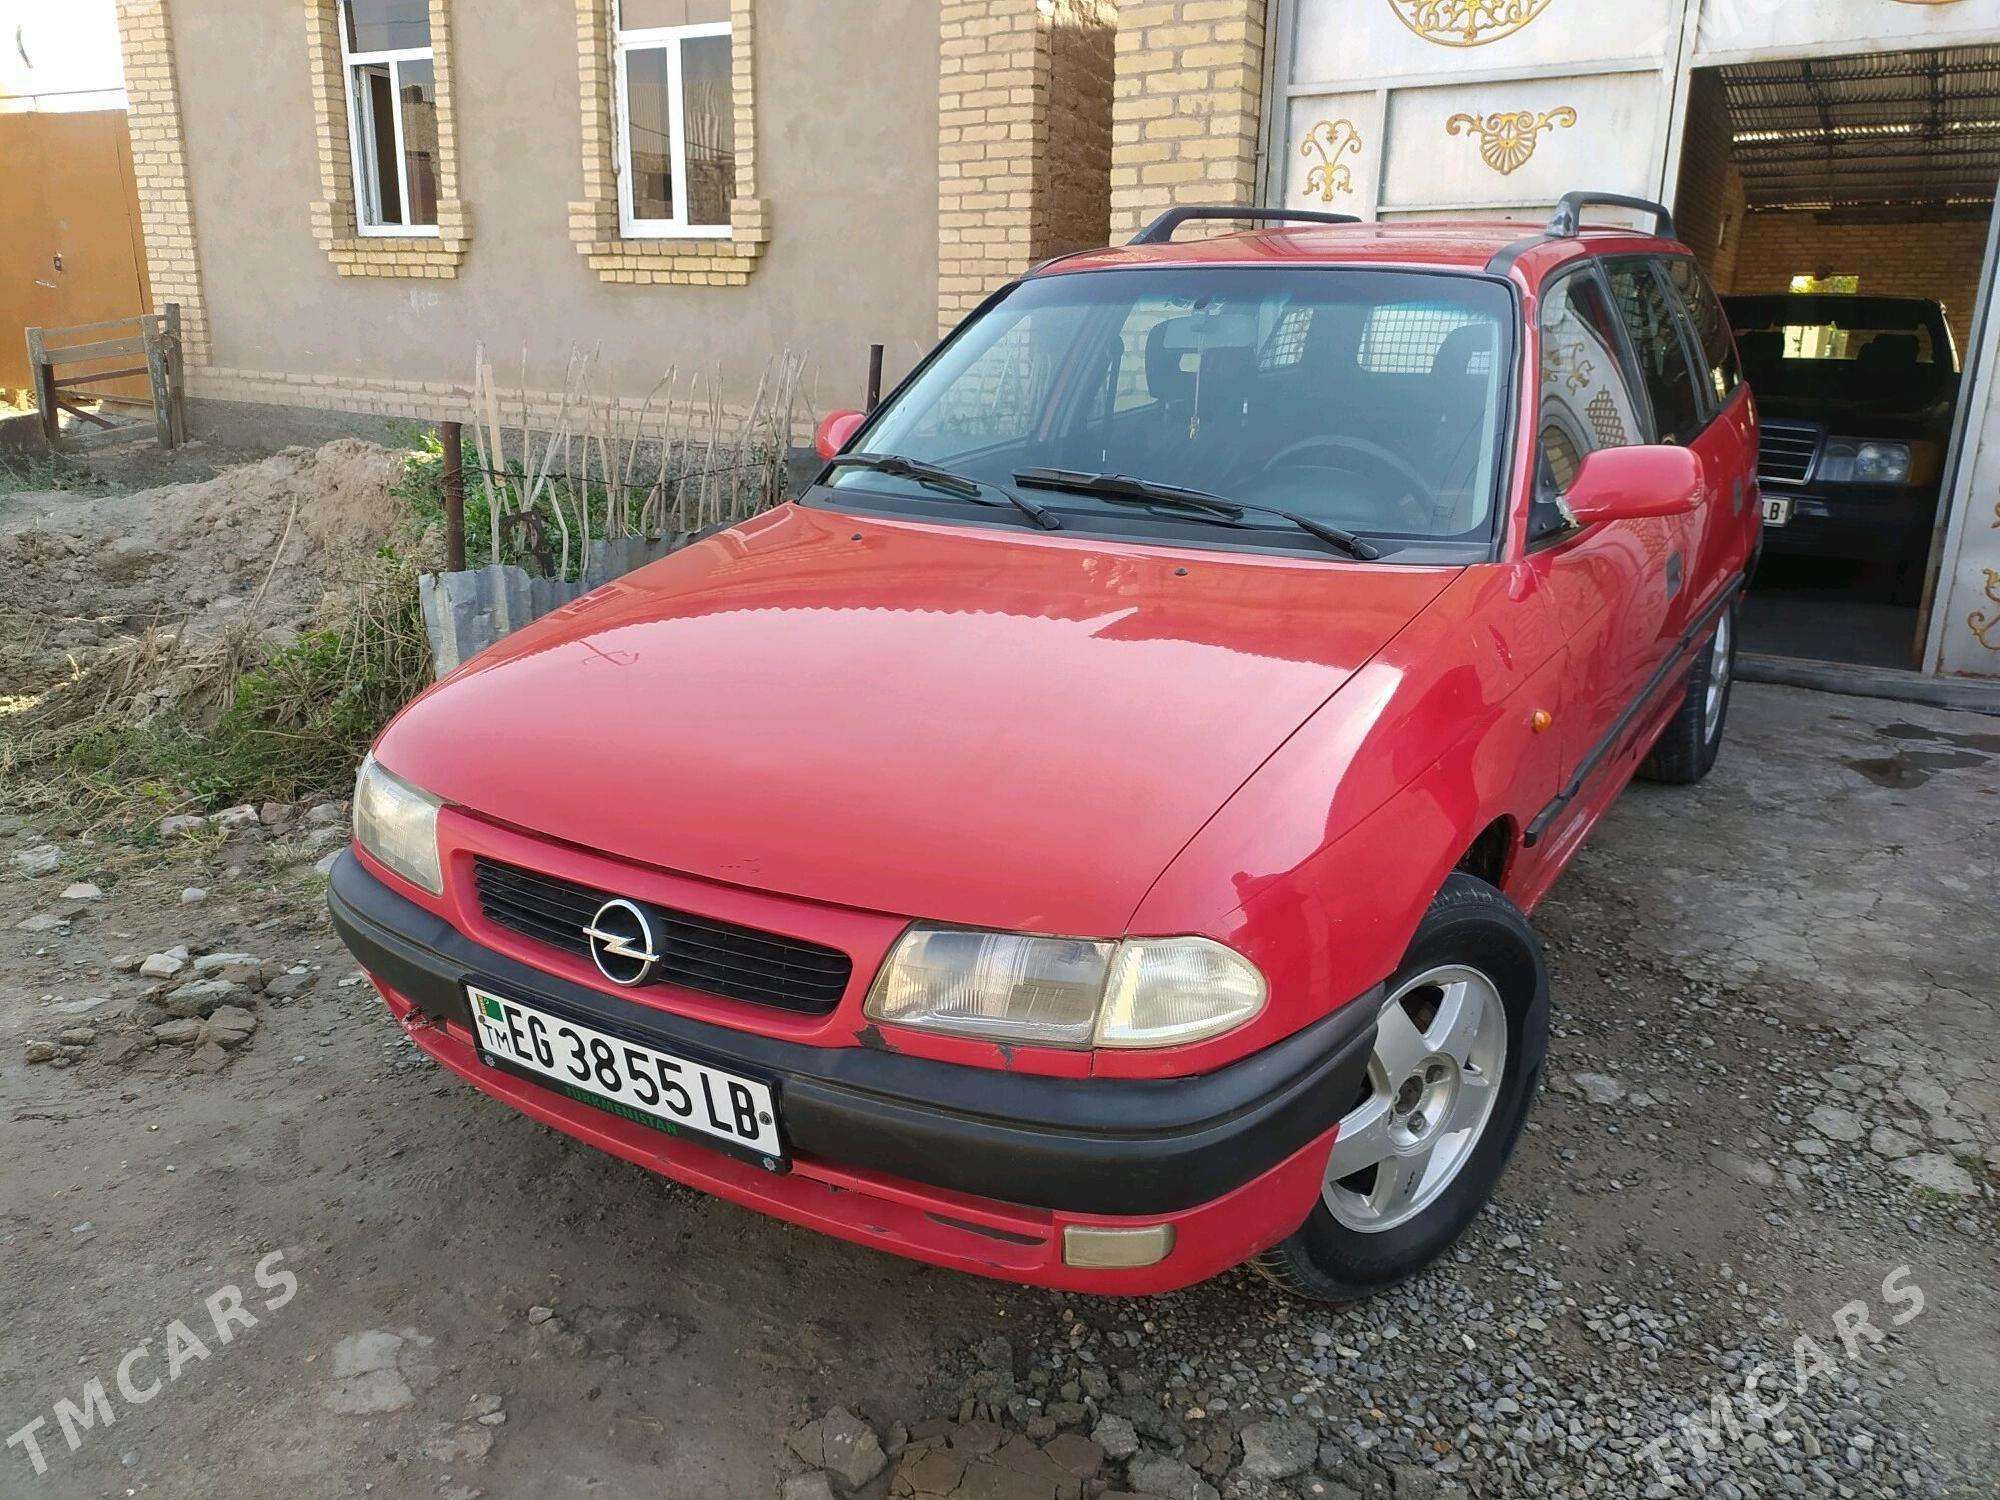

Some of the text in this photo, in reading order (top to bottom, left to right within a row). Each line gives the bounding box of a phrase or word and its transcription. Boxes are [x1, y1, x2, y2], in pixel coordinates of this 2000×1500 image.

[484, 1023, 513, 1054] TM
[503, 1005, 760, 1141] EG 3855 LB
